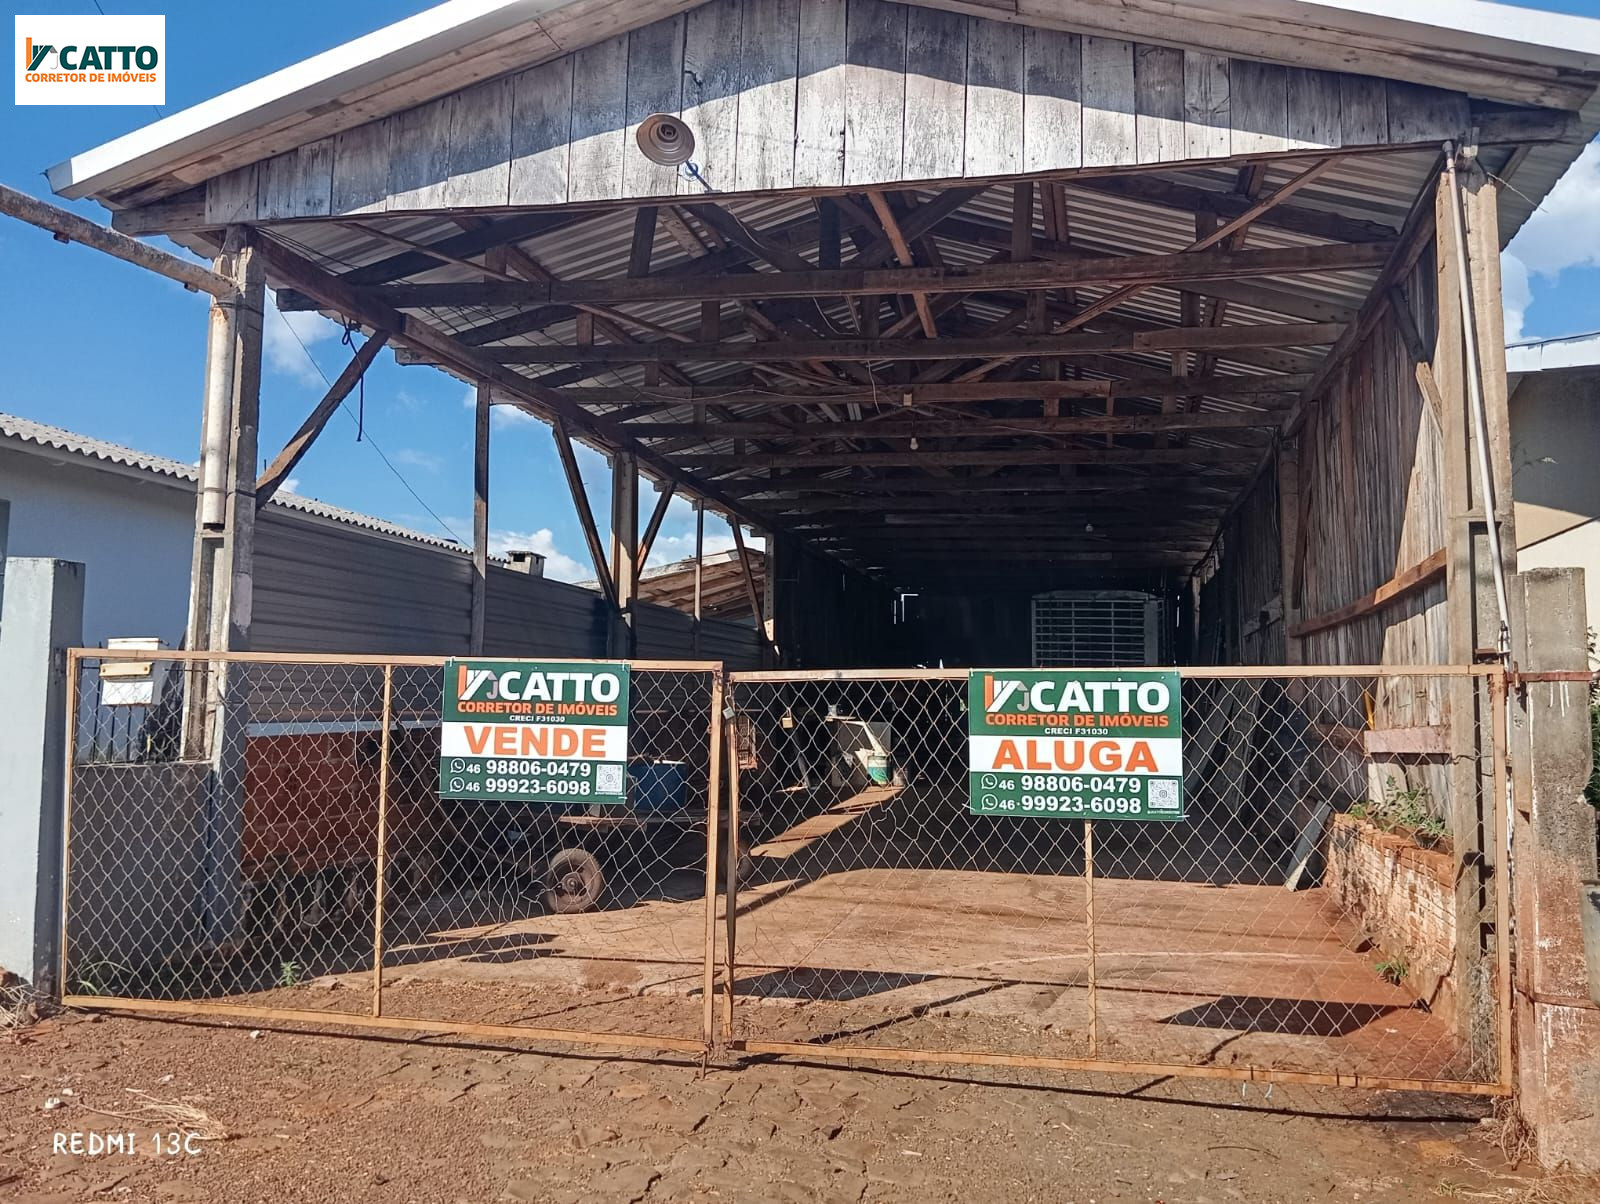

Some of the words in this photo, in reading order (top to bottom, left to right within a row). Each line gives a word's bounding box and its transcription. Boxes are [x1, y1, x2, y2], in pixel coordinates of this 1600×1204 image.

[457, 701, 531, 714] CORRETOR
[535, 703, 555, 714] DE
[558, 702, 618, 716] IMÓVEIS
[536, 715, 565, 723] F31030
[985, 714, 1069, 726] CORRETOR
[1074, 714, 1095, 726] DE
[1100, 713, 1169, 727] IMÓVEIS
[1044, 727, 1073, 735] CRECI
[463, 725, 606, 758] VENDE
[992, 740, 1159, 772] ALUGA
[466, 764, 481, 774] 46
[486, 759, 591, 777] 98806-0479
[465, 782, 480, 792] 46
[485, 778, 590, 795] 99923-6098
[999, 779, 1015, 790] 46
[1021, 775, 1141, 793] 98806-0479
[999, 799, 1015, 810] 46
[1021, 795, 1141, 814] 99923-6098
